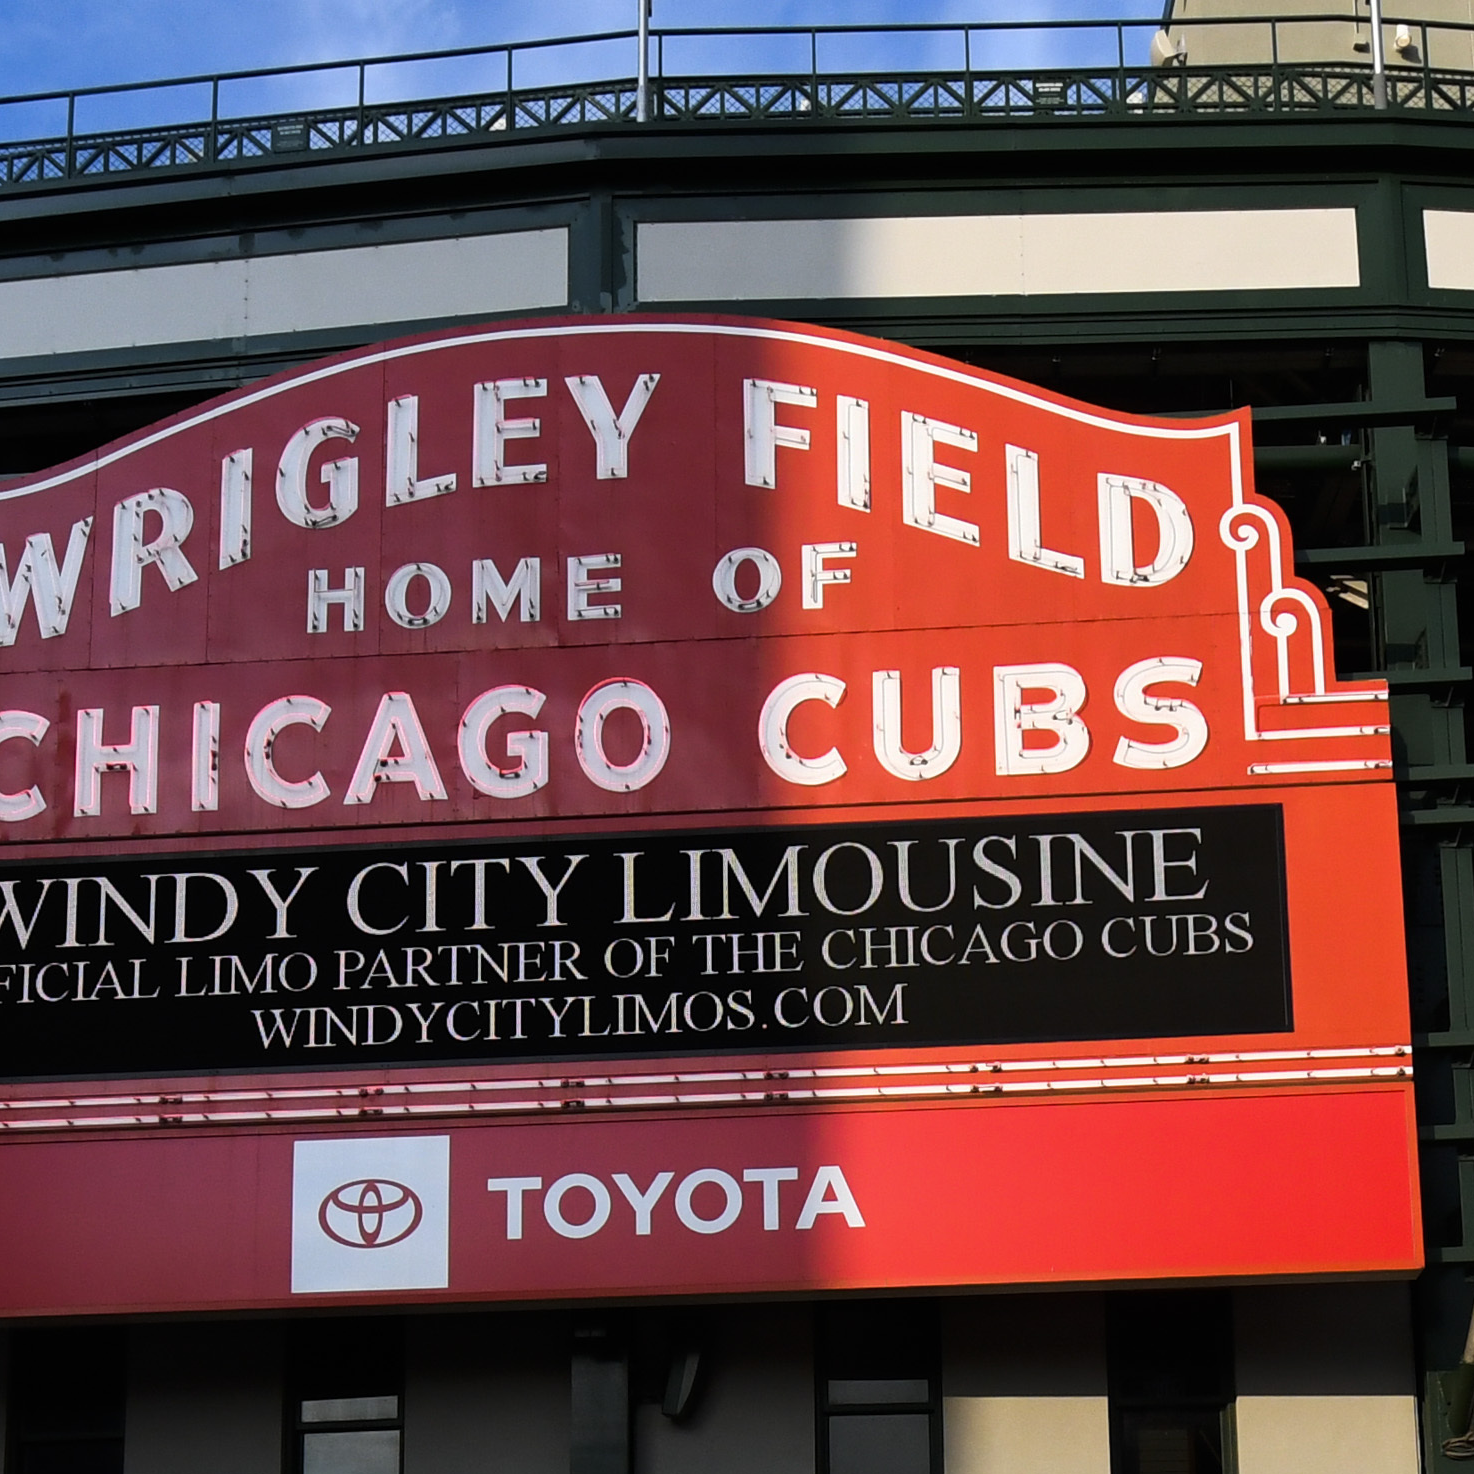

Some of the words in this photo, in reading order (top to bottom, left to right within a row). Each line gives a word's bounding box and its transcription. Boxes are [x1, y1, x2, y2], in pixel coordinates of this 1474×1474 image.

[743, 377, 1194, 587] FIELD
[307, 553, 622, 634] HOME
[712, 542, 857, 612] OF
[758, 655, 1209, 785] CUBS
[346, 854, 590, 936] CITY
[613, 828, 1209, 925] LIMOUSINE
[174, 952, 317, 1003] LIMO
[333, 941, 587, 990] PARTNER
[604, 936, 675, 979] OF
[693, 931, 803, 975] THE
[822, 920, 1083, 970] CHICAGO
[1101, 912, 1254, 957] CUBS
[250, 983, 908, 1050] WINDYCITYLIMOS.COM
[488, 1165, 866, 1240] TOYOTA
